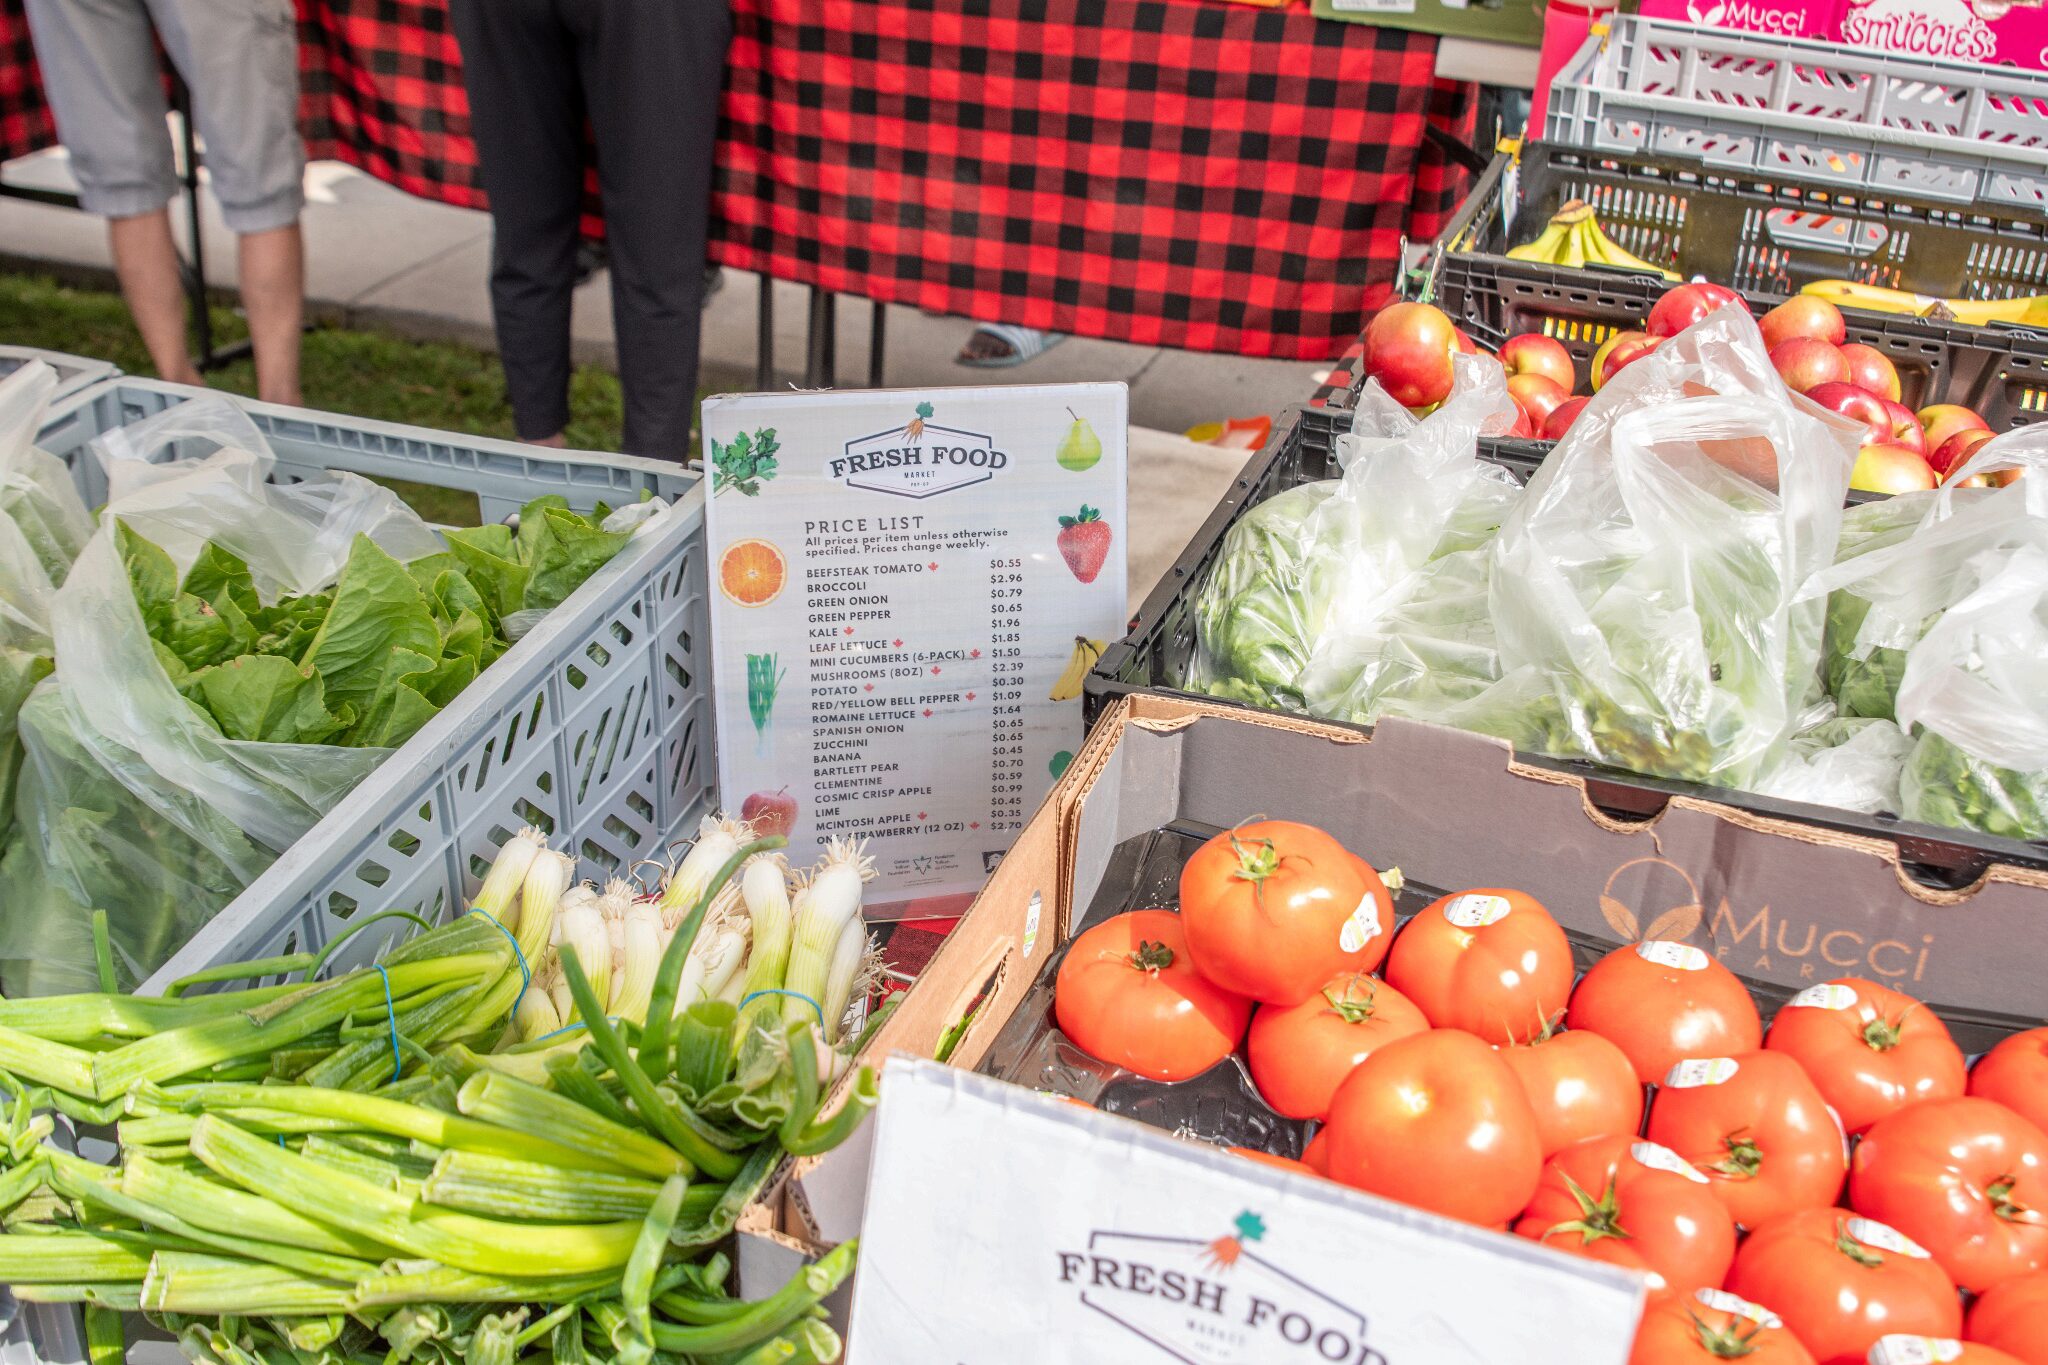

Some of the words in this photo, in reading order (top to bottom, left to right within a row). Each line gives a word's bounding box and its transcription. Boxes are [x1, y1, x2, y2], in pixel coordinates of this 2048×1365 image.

[1725, 1, 1806, 32] Mucci
[830, 446, 922, 478] FRESH
[932, 447, 1007, 470] FOOD
[904, 471, 935, 479] MARKET
[805, 519, 867, 534] PRICE
[879, 516, 924, 531] LIST
[805, 537, 822, 546] All
[825, 536, 859, 548] prices
[862, 535, 881, 547] per
[885, 533, 910, 543] item
[914, 532, 949, 542] unless
[953, 528, 1008, 539] otherwise
[806, 545, 860, 558] specified.
[864, 543, 897, 554] Prices
[901, 542, 942, 555] change
[946, 538, 990, 552] weekly.
[807, 567, 869, 578] BEEFSTEAK
[874, 564, 922, 574] TOMATO
[990, 559, 1021, 569] $0.55
[807, 582, 866, 593] BROCCOLI
[991, 574, 1022, 583] $2.96
[808, 597, 845, 608] GREEN
[850, 595, 888, 605] ONION
[991, 589, 1022, 599] $0.79
[809, 612, 845, 622] GREEN
[850, 610, 891, 620] PEPPER
[991, 604, 1022, 613] $0.65
[809, 628, 838, 638] KALE
[992, 619, 1020, 628] $1.96
[810, 642, 837, 652] LEAF
[840, 640, 887, 651] LETTUCE
[992, 633, 1020, 643] $1.85
[811, 658, 836, 668] MINI
[840, 654, 908, 665] CUCUMBERS
[913, 650, 965, 663] (6-PACK)
[992, 648, 1020, 657] $1.50
[811, 670, 885, 682] MUSHROOMS
[993, 663, 1023, 672] $2.39
[812, 686, 857, 696] POTATO
[993, 677, 1024, 686] $0.30
[812, 698, 886, 710] RED/YELLOW
[891, 697, 915, 706] BELL
[920, 694, 959, 704] PEPPER
[993, 692, 1021, 701] $1.09
[812, 713, 865, 723] ROMAINE
[869, 711, 915, 720] LETTUCE
[993, 706, 1021, 715] $1.64
[813, 727, 862, 737] SPANISH
[866, 725, 904, 733] ONION
[993, 719, 1023, 729] $0.65
[814, 739, 868, 750] ZUCCHINI
[993, 733, 1023, 742] $0.65
[814, 753, 861, 763] BANANA
[992, 746, 1023, 755] $0.45
[814, 766, 866, 777] BARTLETT
[871, 763, 899, 772] PEAR
[992, 759, 1023, 768] $0.70
[815, 777, 882, 790] CLEMENTINE
[992, 772, 1022, 781] $0.59
[815, 792, 859, 803] COSMIC
[863, 789, 894, 799] CRISP
[899, 787, 932, 796] APPLE
[992, 785, 1022, 793] $0.99
[816, 808, 840, 817] LIME
[991, 797, 1021, 805] $0.45
[816, 817, 874, 831] MCINTOSH
[878, 814, 911, 824] APPLE
[991, 809, 1021, 818] $0.35
[924, 825, 942, 834] (12
[944, 822, 964, 832] OZ)
[991, 822, 1022, 830] $2.70
[1709, 896, 1934, 981] Mucci
[1716, 947, 1904, 993] FARS
[1057, 1251, 1228, 1314] FRESH
